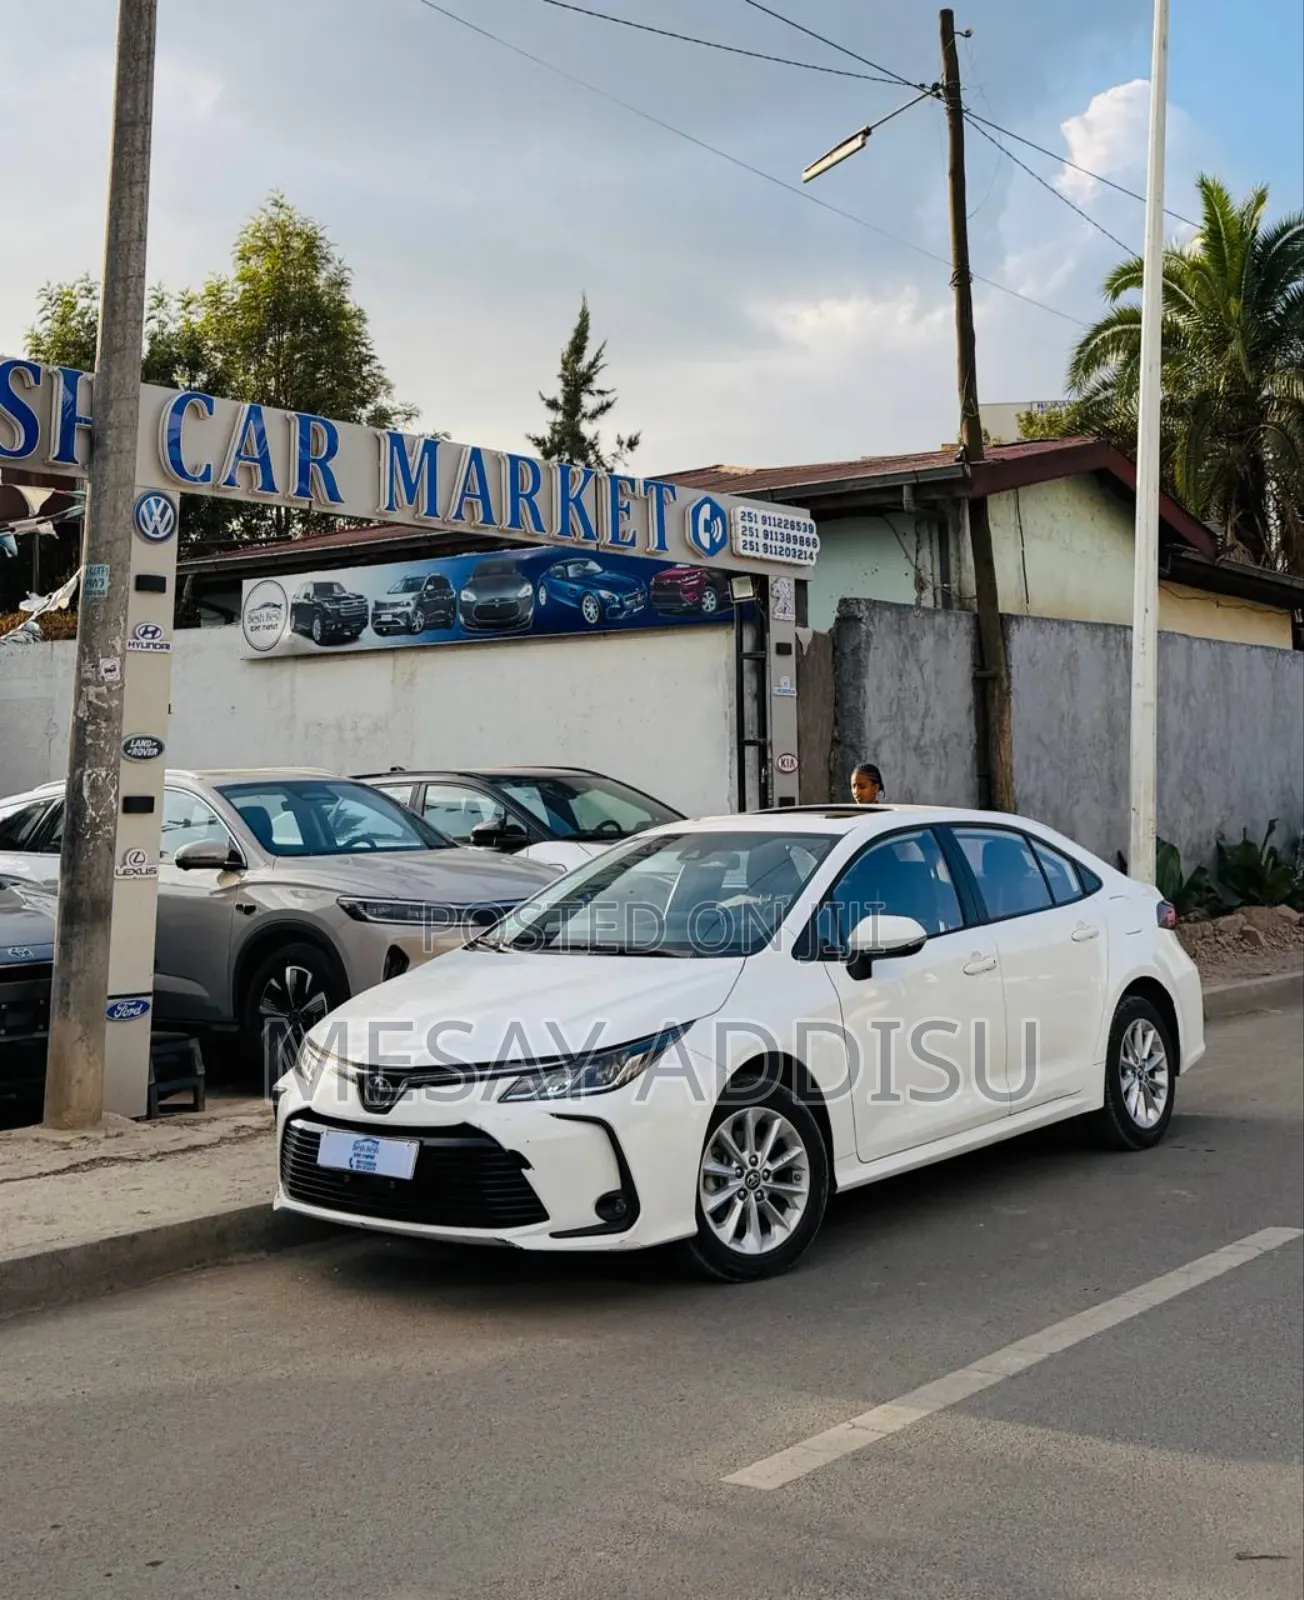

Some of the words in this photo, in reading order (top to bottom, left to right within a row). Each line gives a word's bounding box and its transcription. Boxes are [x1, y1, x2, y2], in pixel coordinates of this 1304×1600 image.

[161, 391, 345, 505] CAR
[377, 429, 677, 554] MARKET
[740, 511, 758, 524] 251
[761, 515, 814, 534] 911226539
[741, 525, 759, 538] 251
[742, 540, 759, 552] 251
[762, 543, 814, 560] 911203214
[127, 640, 171, 651] HYUNDAI
[130, 739, 152, 748] LAND
[131, 748, 158, 757] ROVER
[780, 758, 797, 769] KIA
[115, 866, 157, 876] LEXUS
[113, 1000, 144, 1018] Ford
